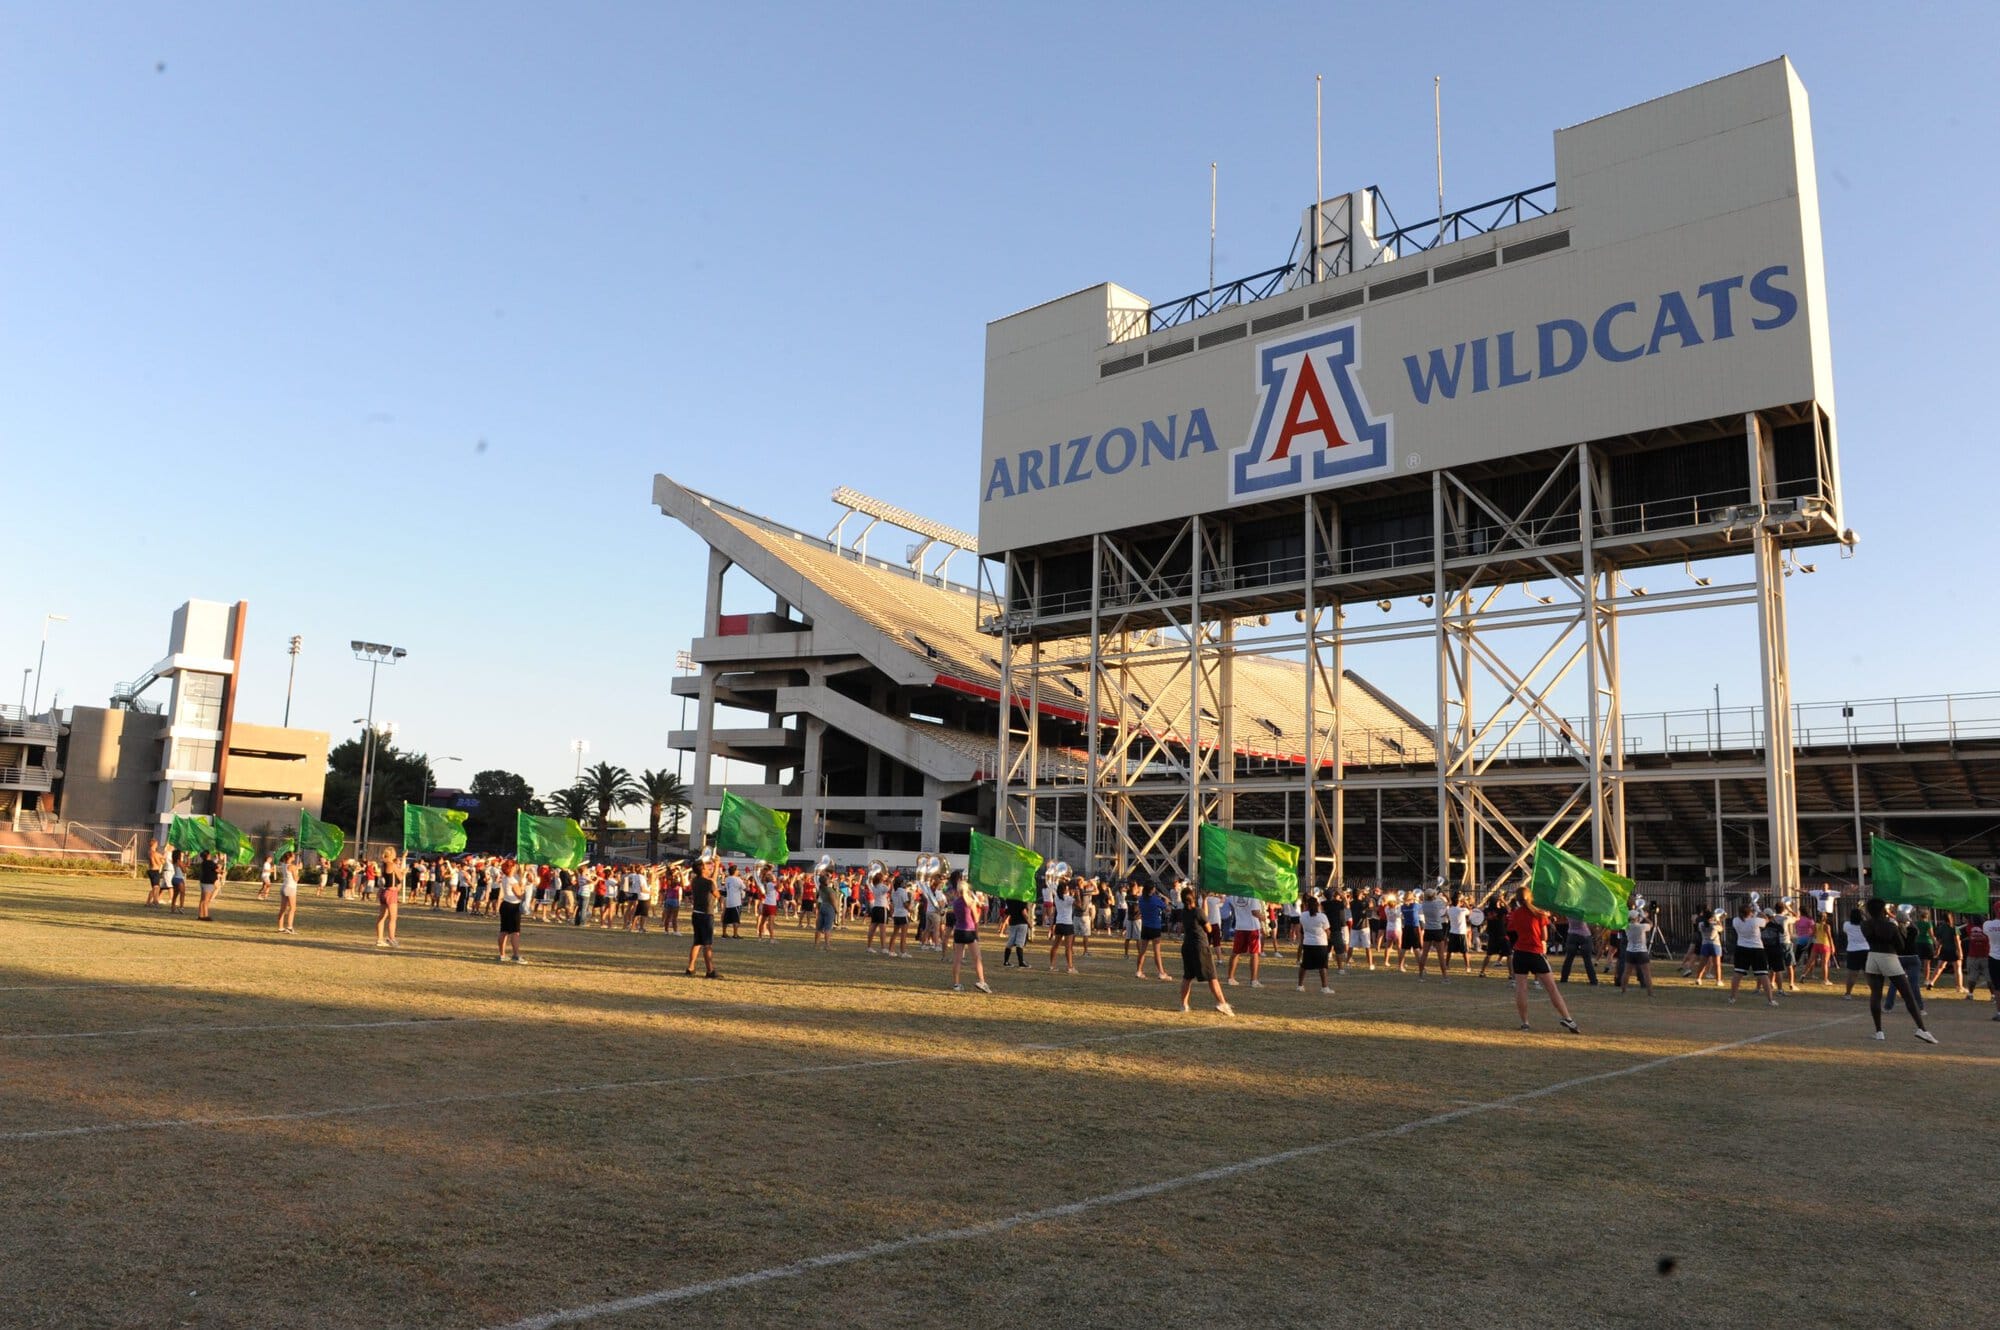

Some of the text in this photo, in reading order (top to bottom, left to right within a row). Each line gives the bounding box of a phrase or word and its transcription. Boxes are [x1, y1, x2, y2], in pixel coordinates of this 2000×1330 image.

[985, 265, 1798, 501] ARIZONA A WILDCATS
